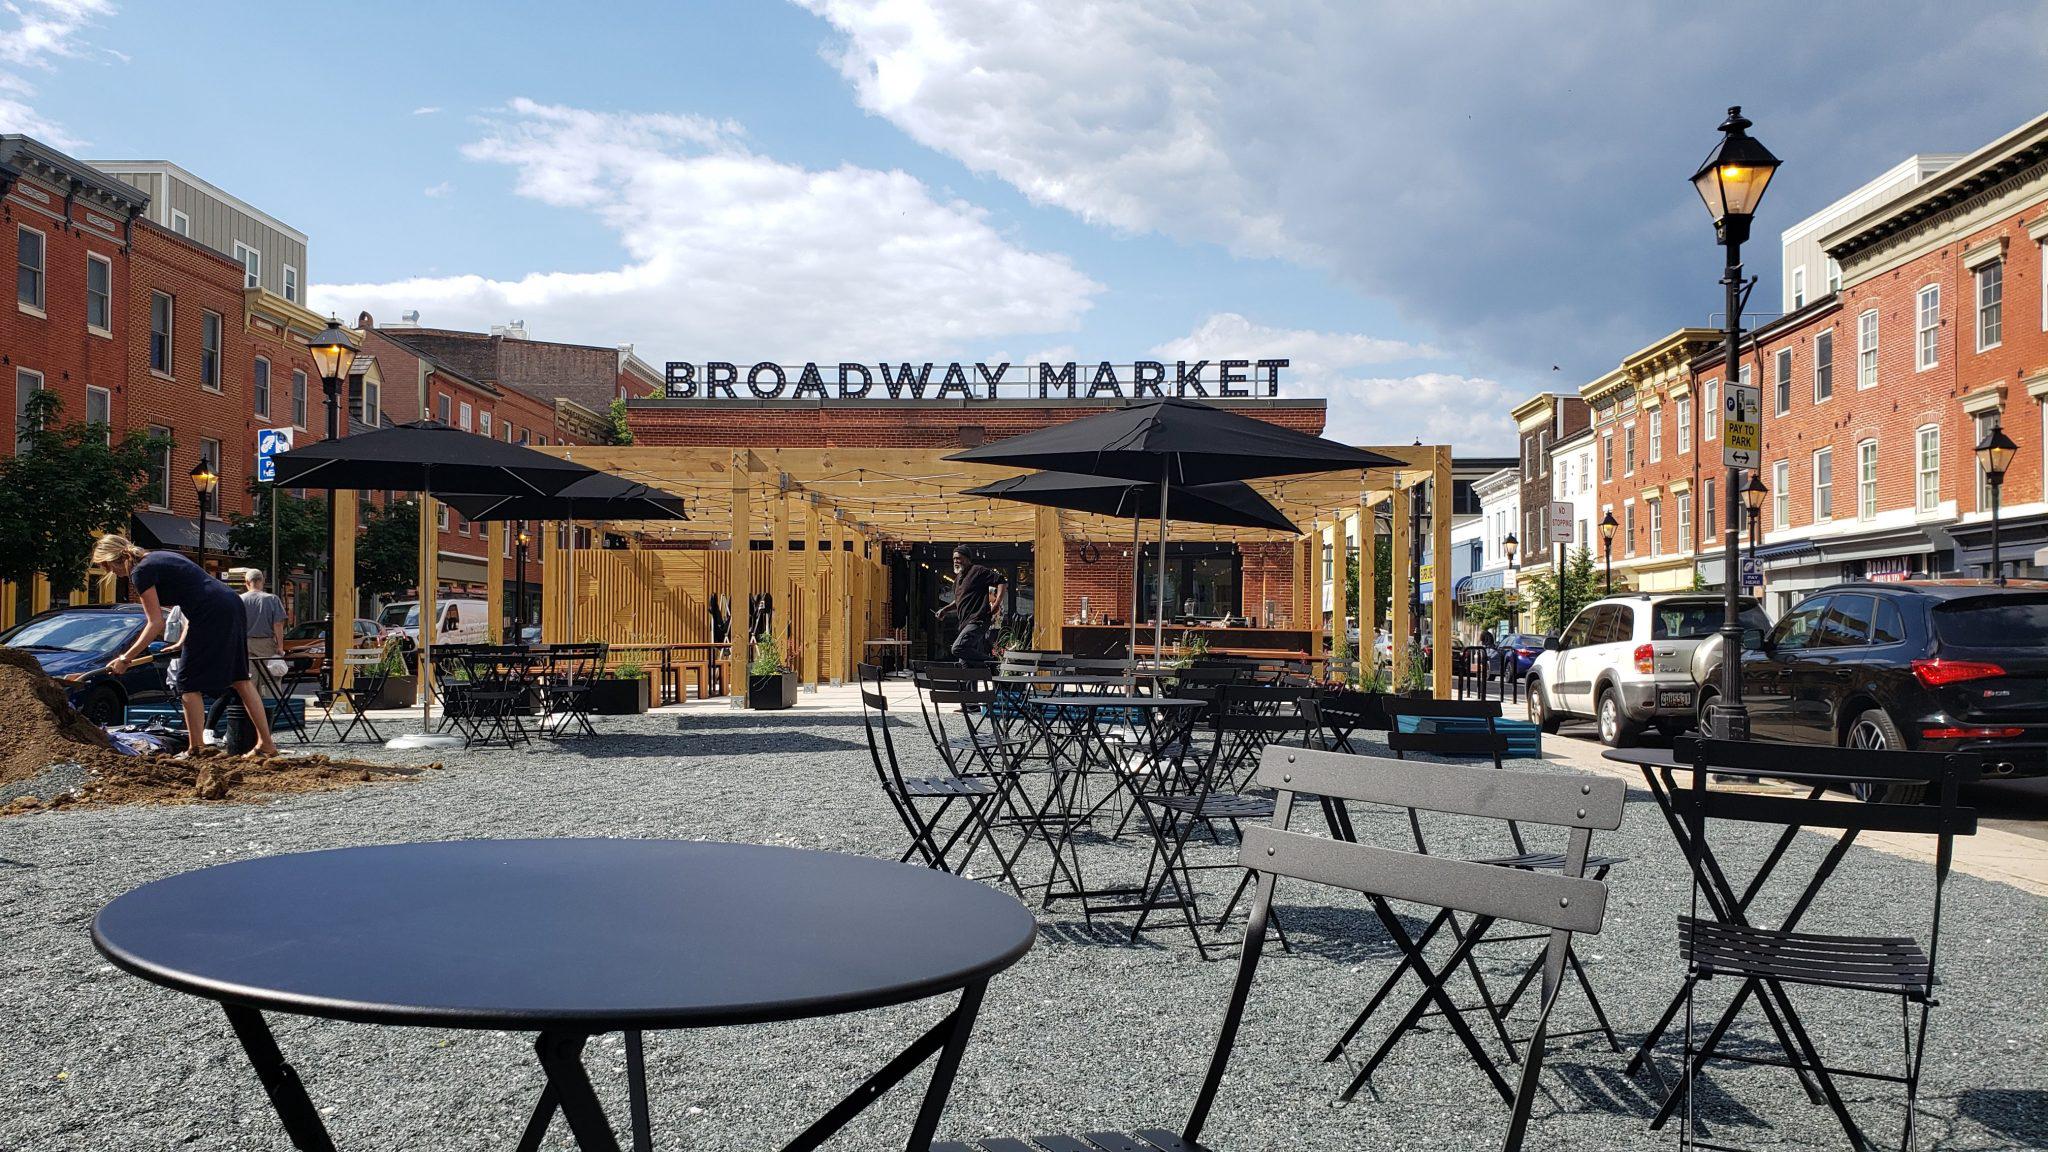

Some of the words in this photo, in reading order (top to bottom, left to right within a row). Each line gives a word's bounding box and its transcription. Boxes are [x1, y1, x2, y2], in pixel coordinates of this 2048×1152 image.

[665, 361, 1009, 399] BROADWAY
[1039, 359, 1290, 398] MARKET
[1729, 423, 1742, 433] PAY
[1744, 425, 1755, 436] TO
[1731, 436, 1751, 447] PARK
[1558, 507, 1566, 515] NO
[1552, 519, 1572, 527] STOPPING
[1866, 556, 1909, 580] BROADWAY
